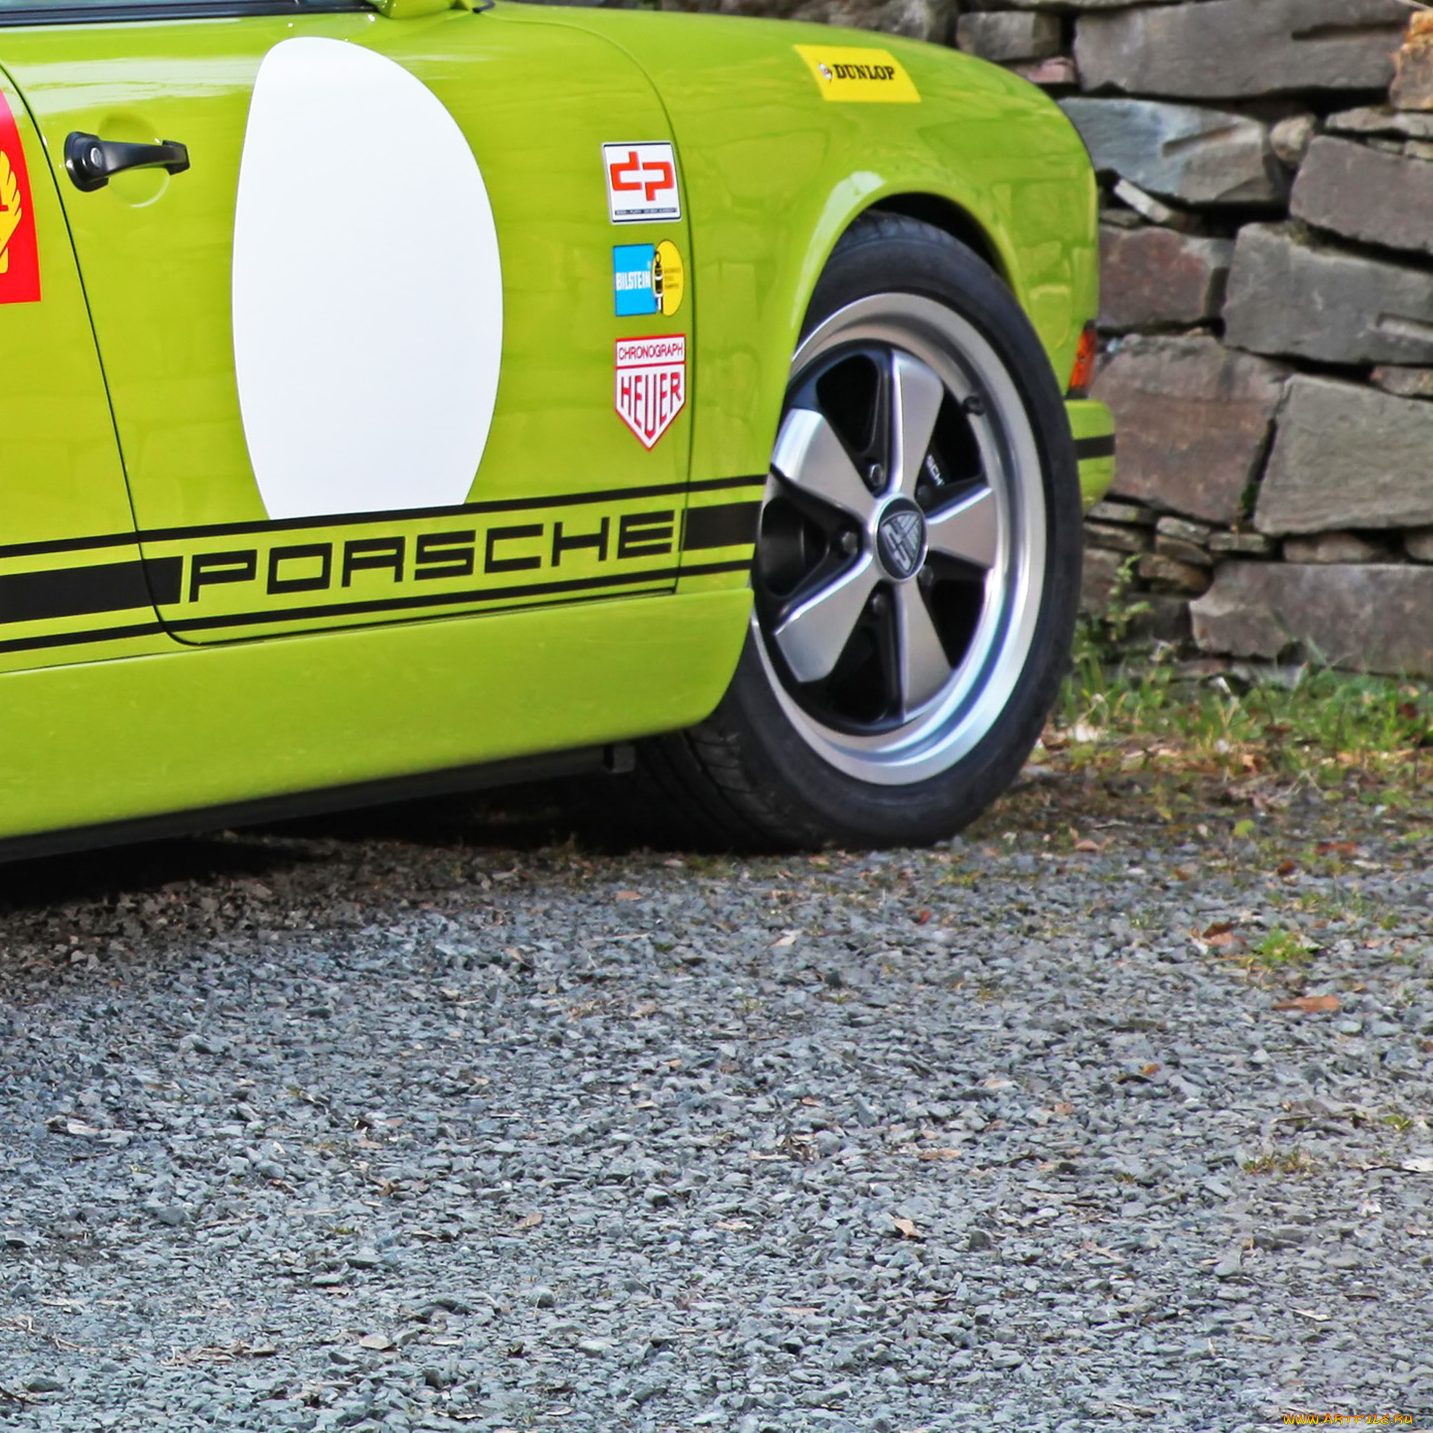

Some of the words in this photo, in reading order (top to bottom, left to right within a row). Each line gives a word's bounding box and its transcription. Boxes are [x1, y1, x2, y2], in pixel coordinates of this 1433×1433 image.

[832, 64, 894, 80] DUNLOP
[615, 270, 652, 290] BILSTEIN
[618, 343, 683, 360] CHRONOGRAPH
[620, 372, 682, 440] HEUER
[189, 509, 676, 604] PORSCHE
